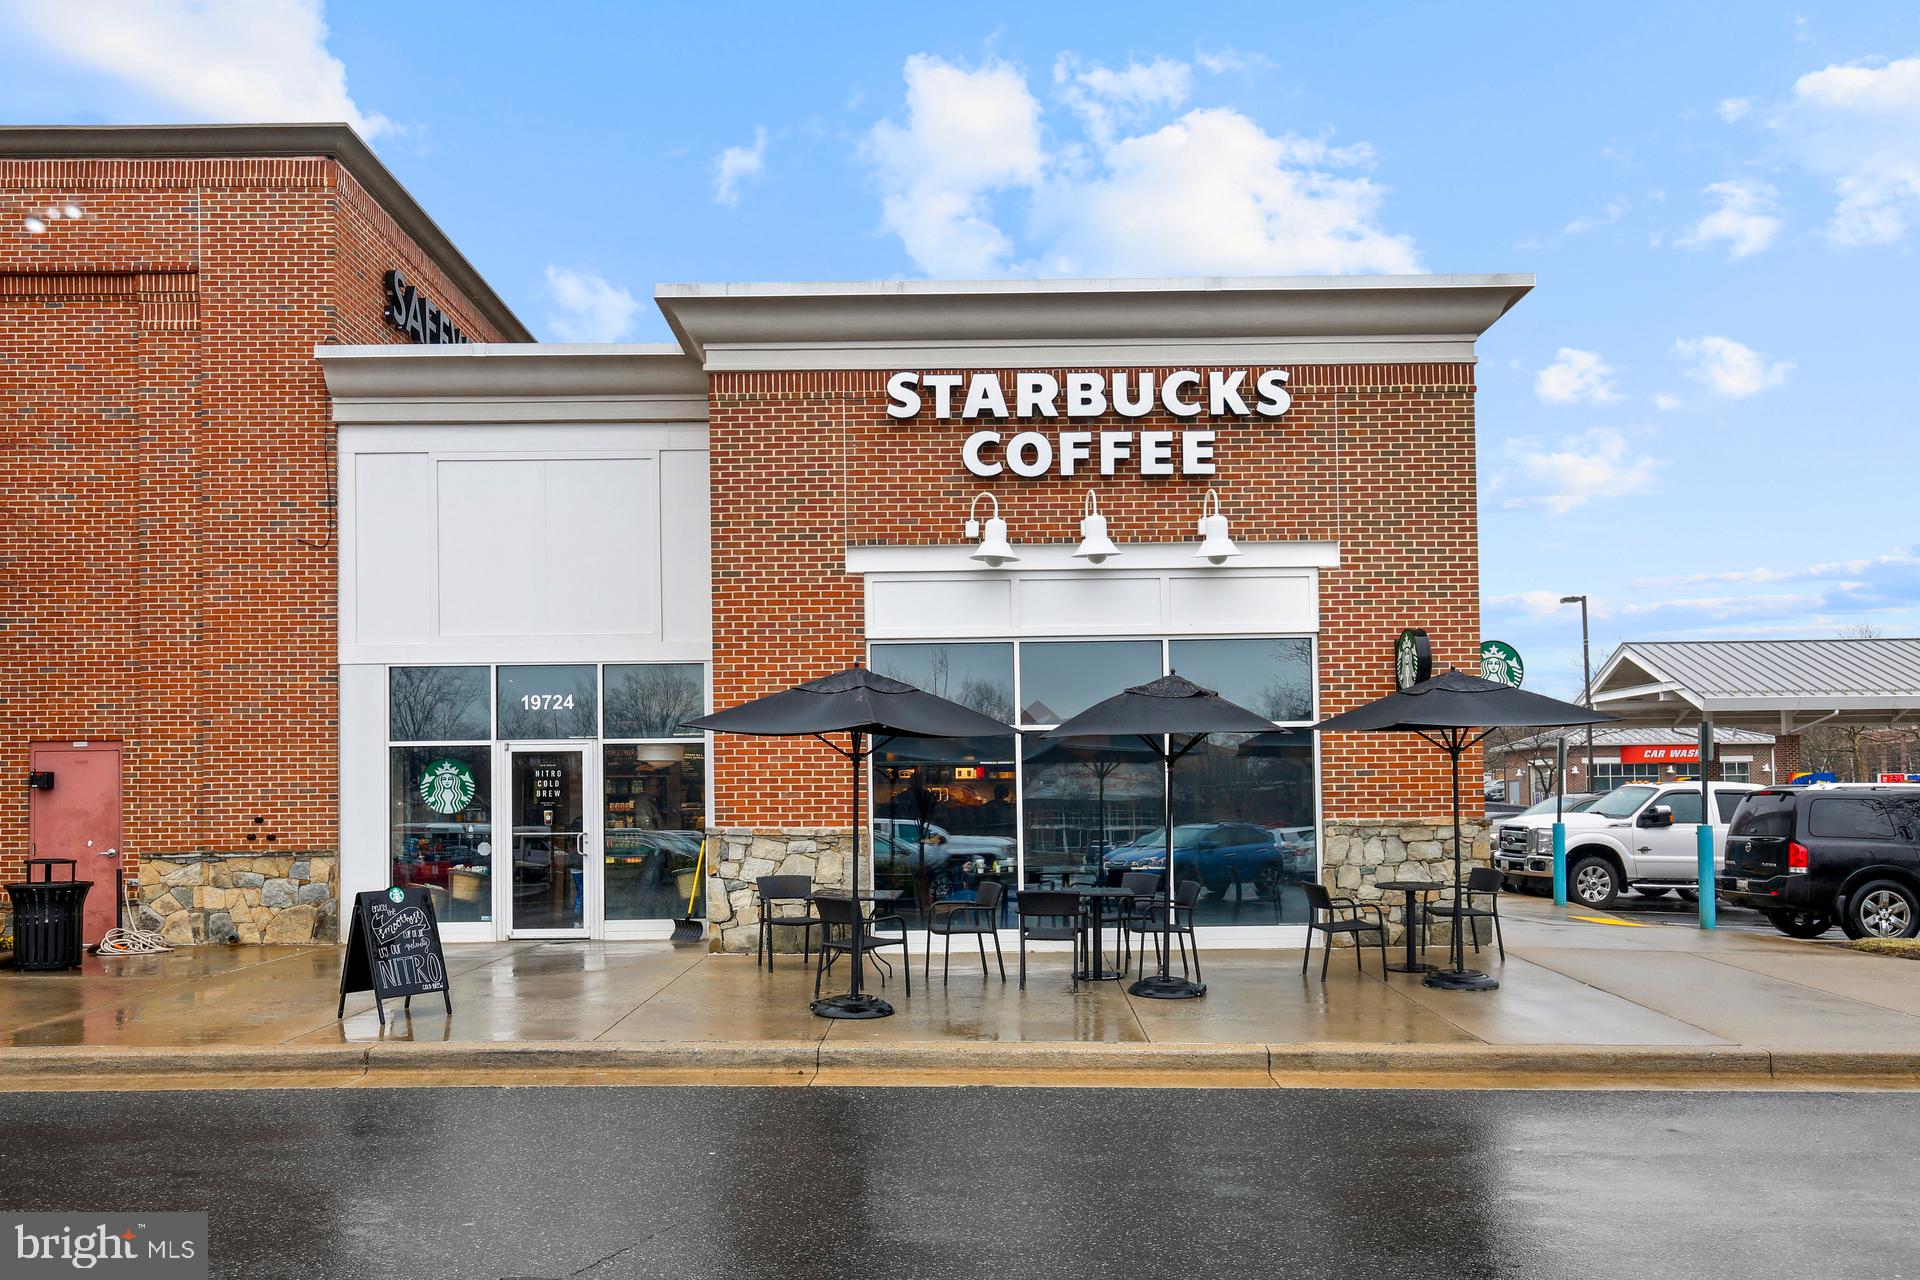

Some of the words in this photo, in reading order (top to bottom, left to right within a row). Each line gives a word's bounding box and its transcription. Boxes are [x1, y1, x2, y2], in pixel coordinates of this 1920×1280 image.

[886, 370, 1292, 419] STARBUCKS
[962, 430, 1217, 478] COFFEE
[521, 694, 575, 710] 19724
[1643, 749, 1666, 758] CAR
[535, 770, 562, 778] NITRO
[537, 780, 560, 788] COLD
[378, 910, 421, 939] smoothest
[378, 952, 443, 989] NITRO
